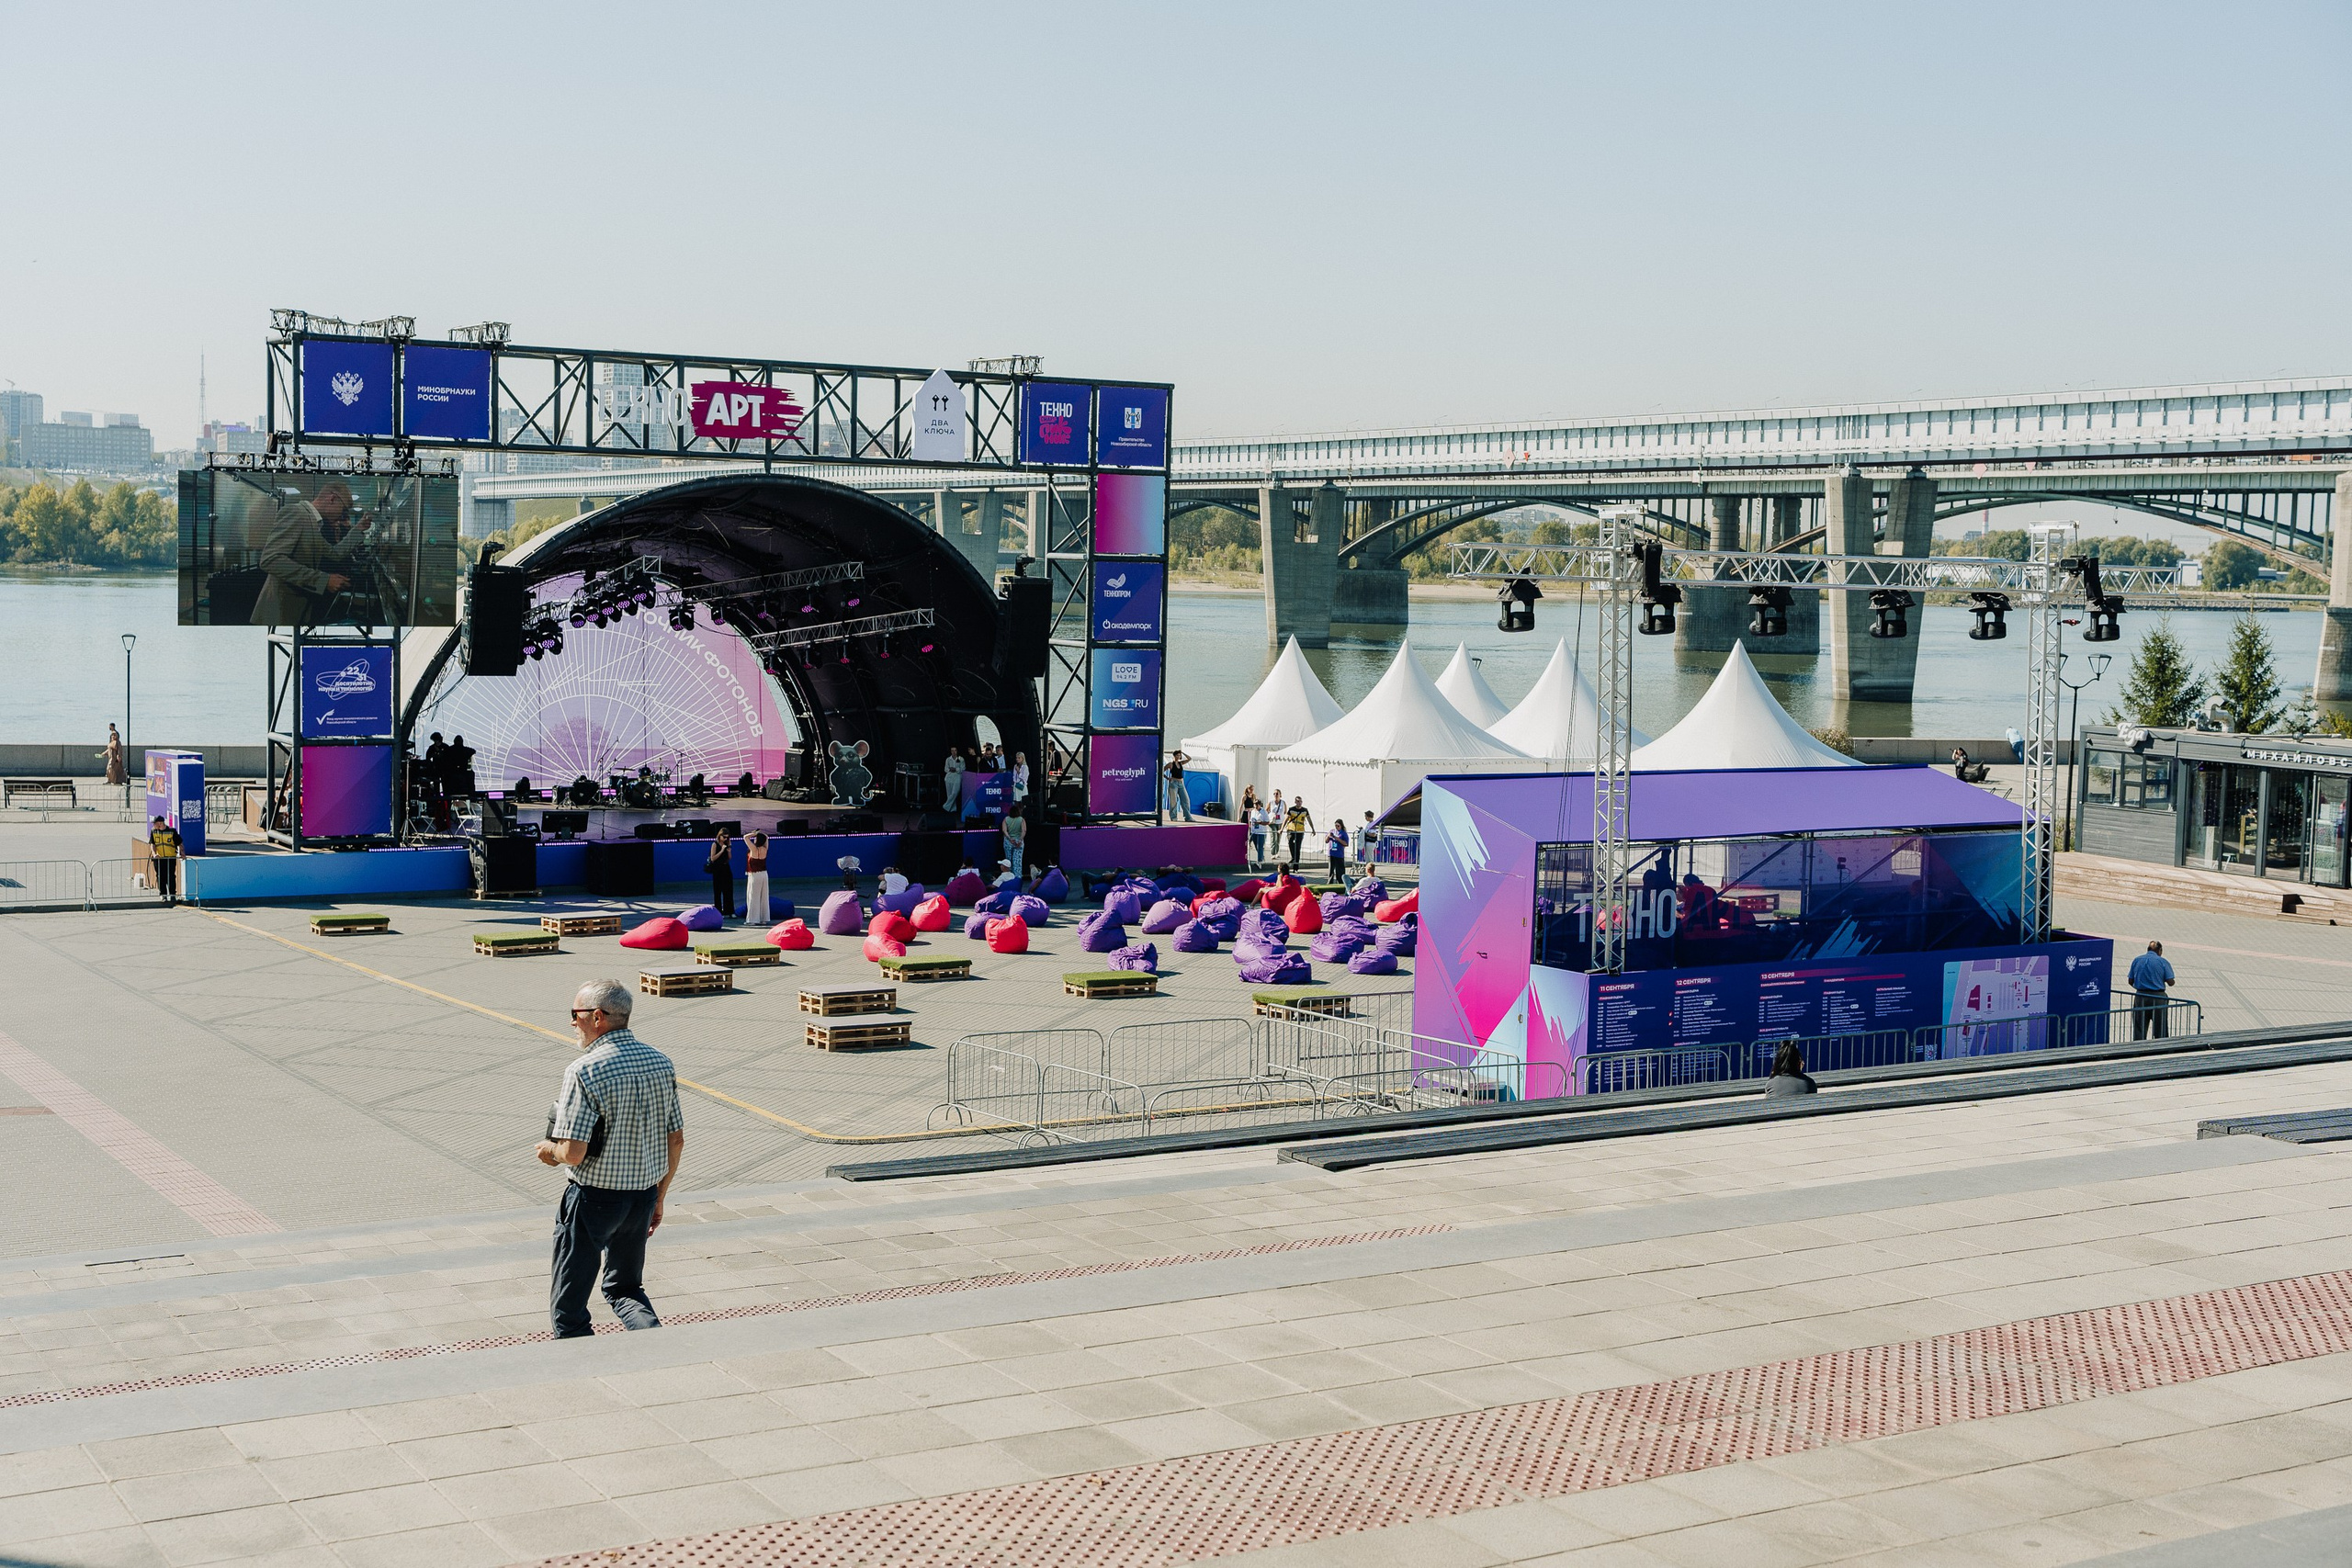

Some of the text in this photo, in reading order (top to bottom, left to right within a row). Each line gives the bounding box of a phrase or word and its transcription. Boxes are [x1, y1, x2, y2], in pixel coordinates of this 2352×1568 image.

[417, 385, 476, 395] МИНОБРНАУКИ
[417, 393, 449, 402] РОССИИ
[594, 383, 765, 427] ТЕХНО АРТ
[1039, 401, 1073, 418] ТЕХНО
[924, 427, 956, 435] КЛЮЧА
[1103, 590, 1131, 598] ТЕХНОПРОМ
[1111, 623, 1152, 631] академпарк
[347, 667, 359, 675] 22
[704, 650, 764, 738] ФОТОНОВ
[1102, 698, 1148, 708] NGS RU
[1102, 767, 1146, 779] petroglyph
